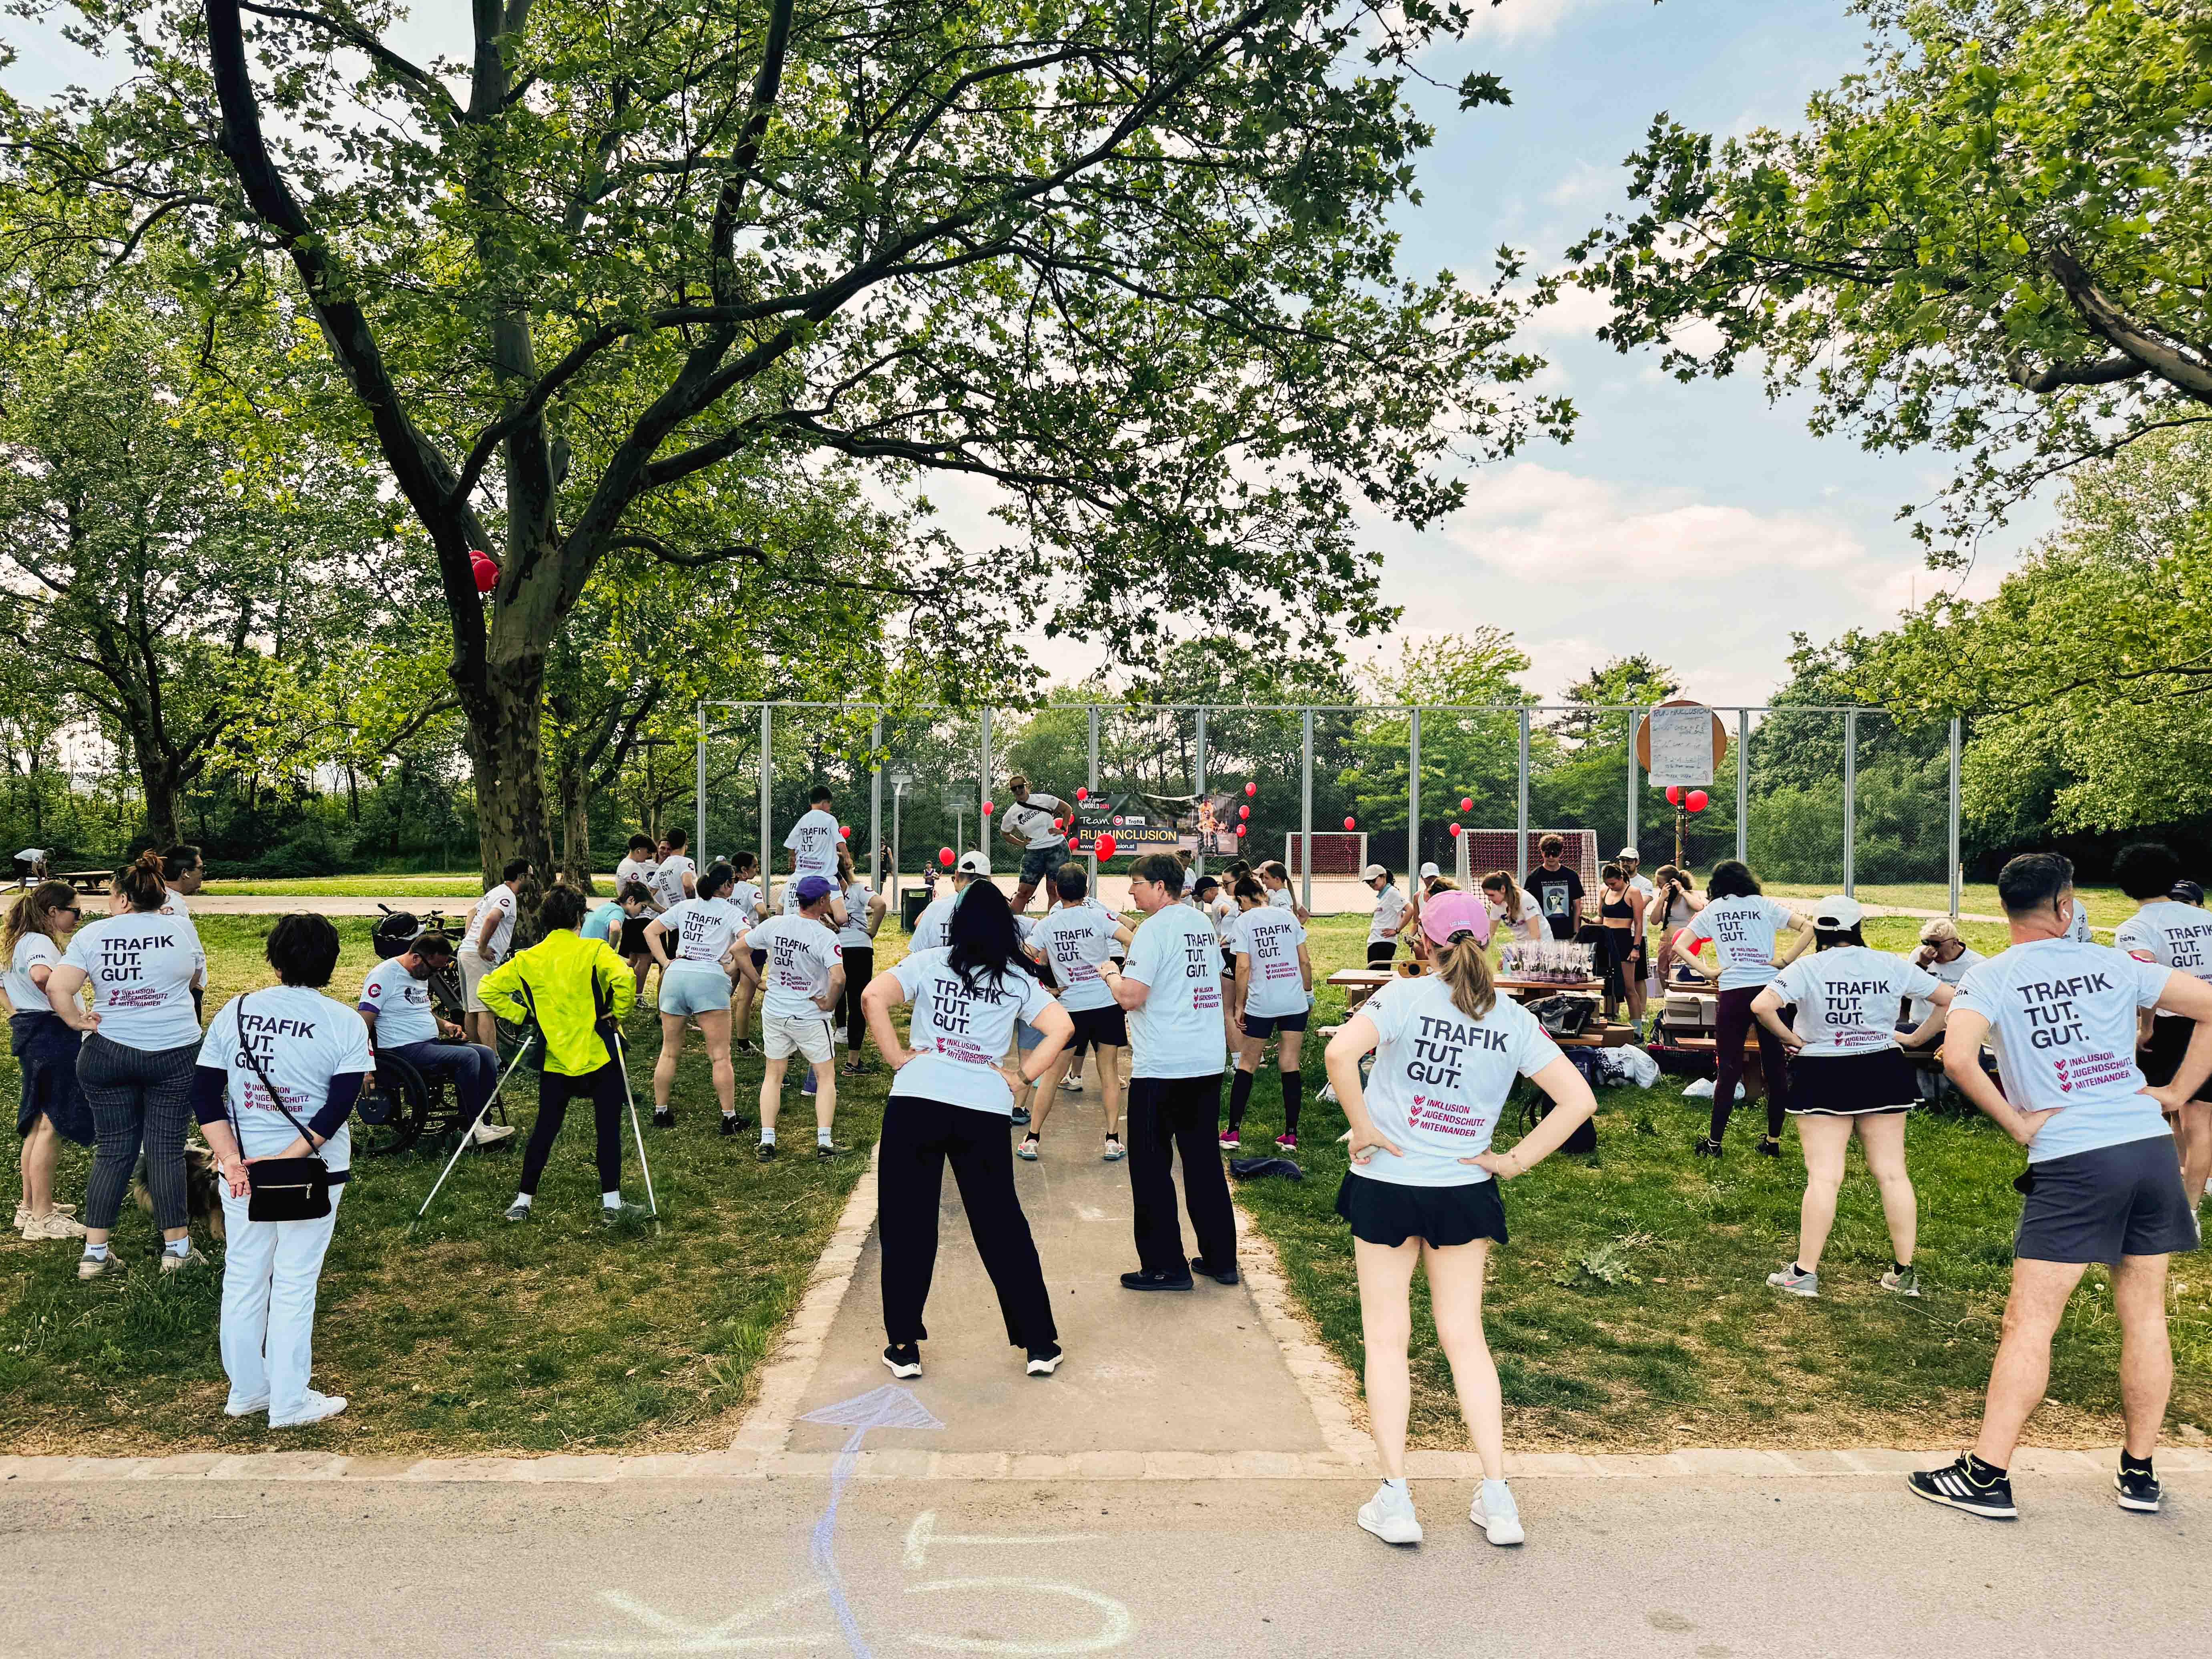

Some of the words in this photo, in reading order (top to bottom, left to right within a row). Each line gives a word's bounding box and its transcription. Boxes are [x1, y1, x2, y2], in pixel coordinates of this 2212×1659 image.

[1080, 816, 1109, 824] Team
[1080, 830, 1176, 841] RUNINCLUSION
[687, 912, 722, 925] TRAFIK
[1714, 911, 1761, 922] TRAFIK
[685, 921, 703, 933] TUT.
[1252, 924, 1292, 937] TRAFIK
[1717, 922, 1743, 932] TUT.
[683, 931, 703, 942] GUT.
[1053, 928, 1093, 941] TRAFIK
[1720, 932, 1747, 942] GUT.
[101, 935, 174, 951] TRAFIK
[775, 936, 810, 954] TRAFIK
[1055, 941, 1078, 951] TUT.
[1255, 936, 1278, 948] TUT.
[2169, 941, 2199, 954] TUT.
[774, 946, 793, 958] TUT.
[1057, 951, 1081, 962] GUT.
[1185, 949, 1205, 962] TUT.
[1258, 947, 1280, 958] GUT.
[101, 953, 141, 966] TUT.
[2172, 954, 2204, 968] GUT.
[101, 967, 143, 981] GUT.
[1187, 964, 1207, 978] GUT.
[1825, 980, 1890, 995] TRAFIK
[2017, 973, 2114, 1004] TRAFIK
[932, 995, 970, 1017] TUT.
[1825, 997, 1862, 1010] TUT.
[1825, 1012, 1864, 1025] GUT.
[2024, 1001, 2079, 1026] TUT.
[240, 1014, 316, 1038] TRAFIK
[933, 1012, 969, 1034] GUT.
[1420, 1016, 1509, 1052] TRAFIK
[2031, 1022, 2089, 1049] GUT.
[947, 1039, 980, 1051] INKLUSION
[1414, 1039, 1463, 1068] TUT.
[2069, 1051, 2115, 1066] INKLUSION
[235, 1052, 274, 1073] GUT.
[1407, 1061, 1461, 1089] GUT.
[2075, 1070, 2130, 1090] MITEINANDER
[253, 1085, 290, 1094] INKLSION
[254, 1094, 309, 1103] JUGESCHUTZ
[1427, 1099, 1470, 1114] INKLUSION
[1422, 1111, 1485, 1126] JUGENDSCHUTZ
[1420, 1121, 1476, 1137] MITEINANDER
